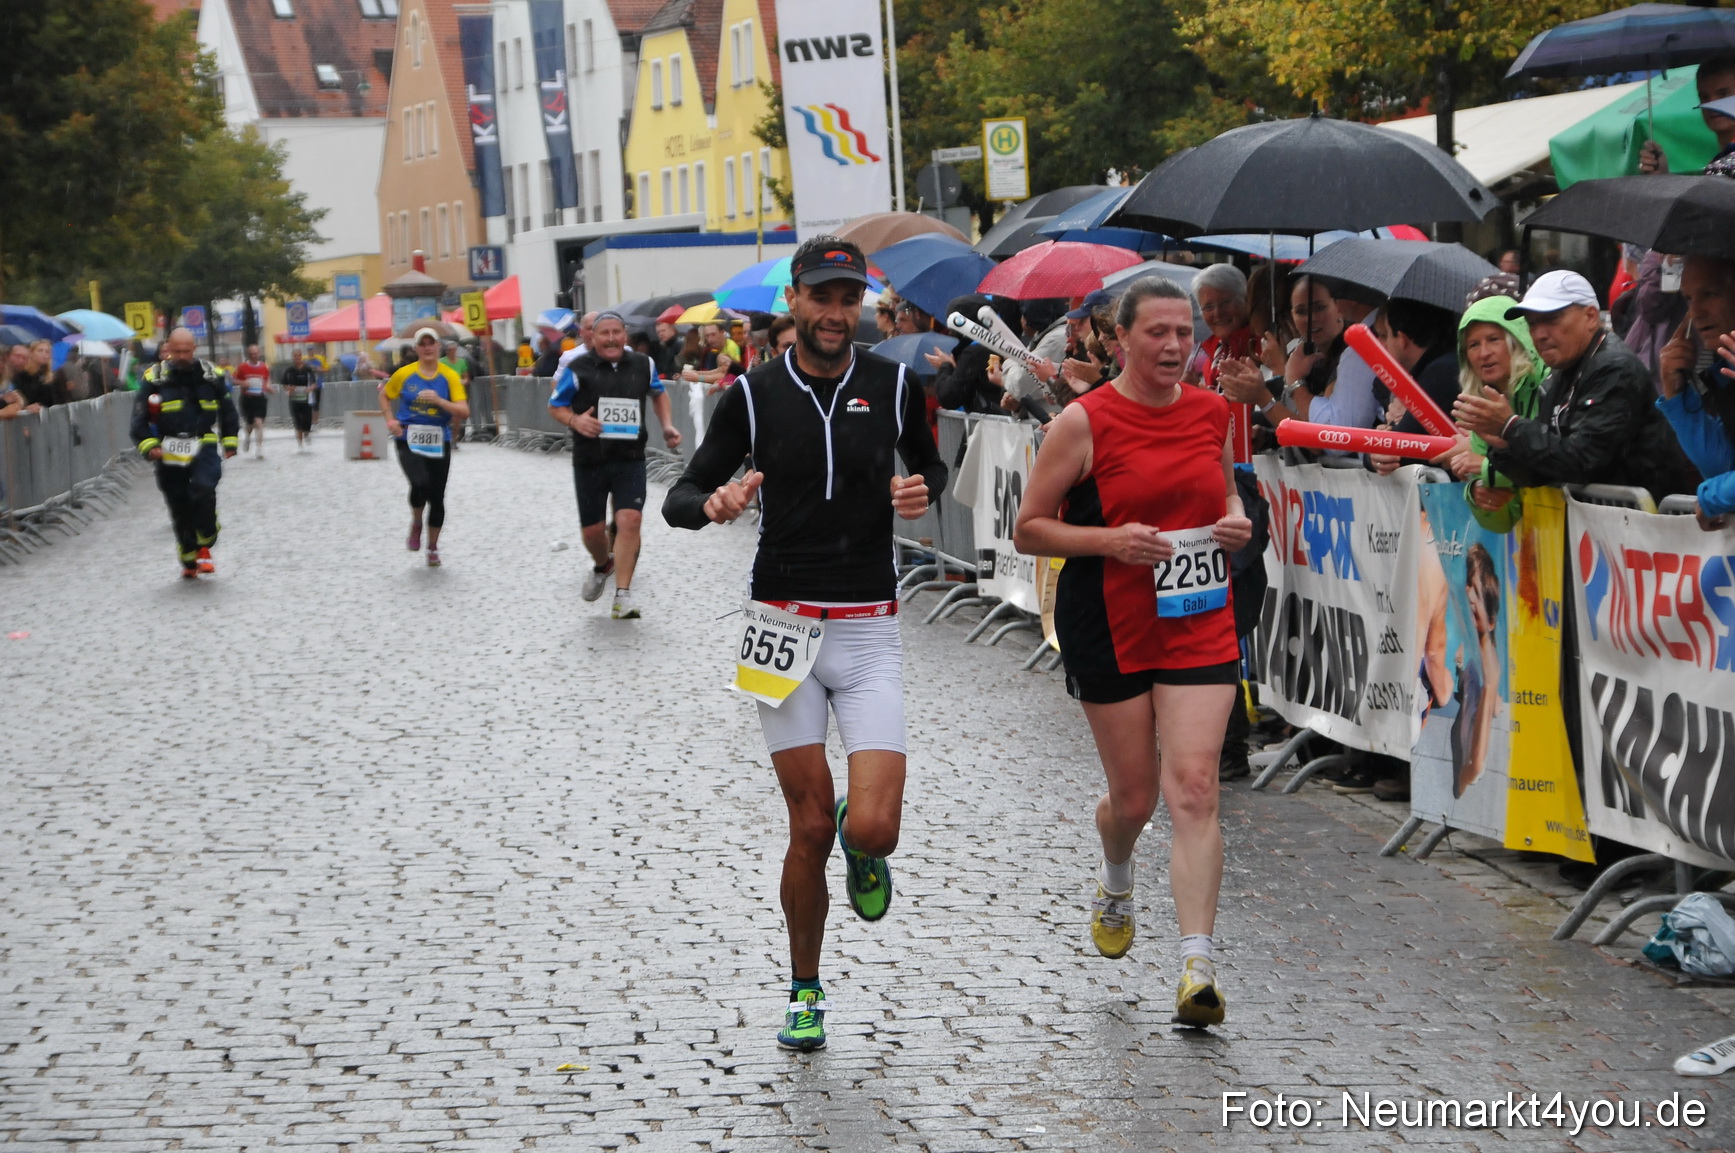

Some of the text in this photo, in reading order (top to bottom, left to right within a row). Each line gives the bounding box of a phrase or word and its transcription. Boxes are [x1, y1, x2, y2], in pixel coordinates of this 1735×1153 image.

[469, 304, 480, 321] D
[133, 314, 145, 331] D
[970, 324, 1001, 346] BMW
[603, 408, 637, 423] 2534
[1363, 435, 1431, 452] Audi BKK
[1179, 535, 1219, 548] Neumark
[1154, 548, 1228, 592] 2250
[1183, 595, 1207, 612] Gabi
[759, 608, 806, 634] Neumarkt
[741, 625, 799, 671] 655
